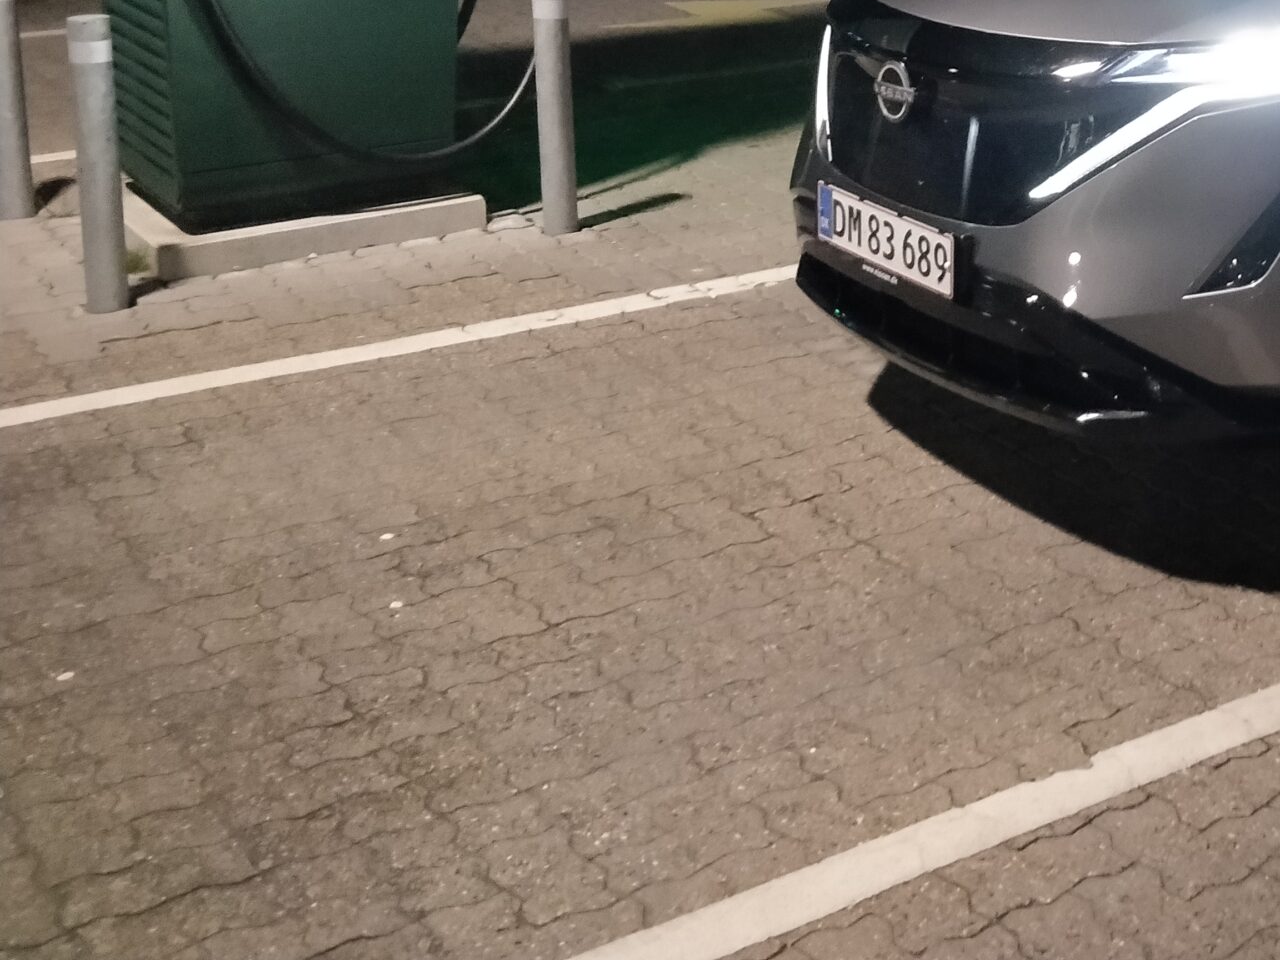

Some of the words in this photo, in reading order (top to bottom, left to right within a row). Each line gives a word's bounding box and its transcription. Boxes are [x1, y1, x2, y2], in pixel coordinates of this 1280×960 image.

[833, 199, 862, 247] DM
[868, 214, 895, 260] 83
[902, 228, 948, 284] 689
